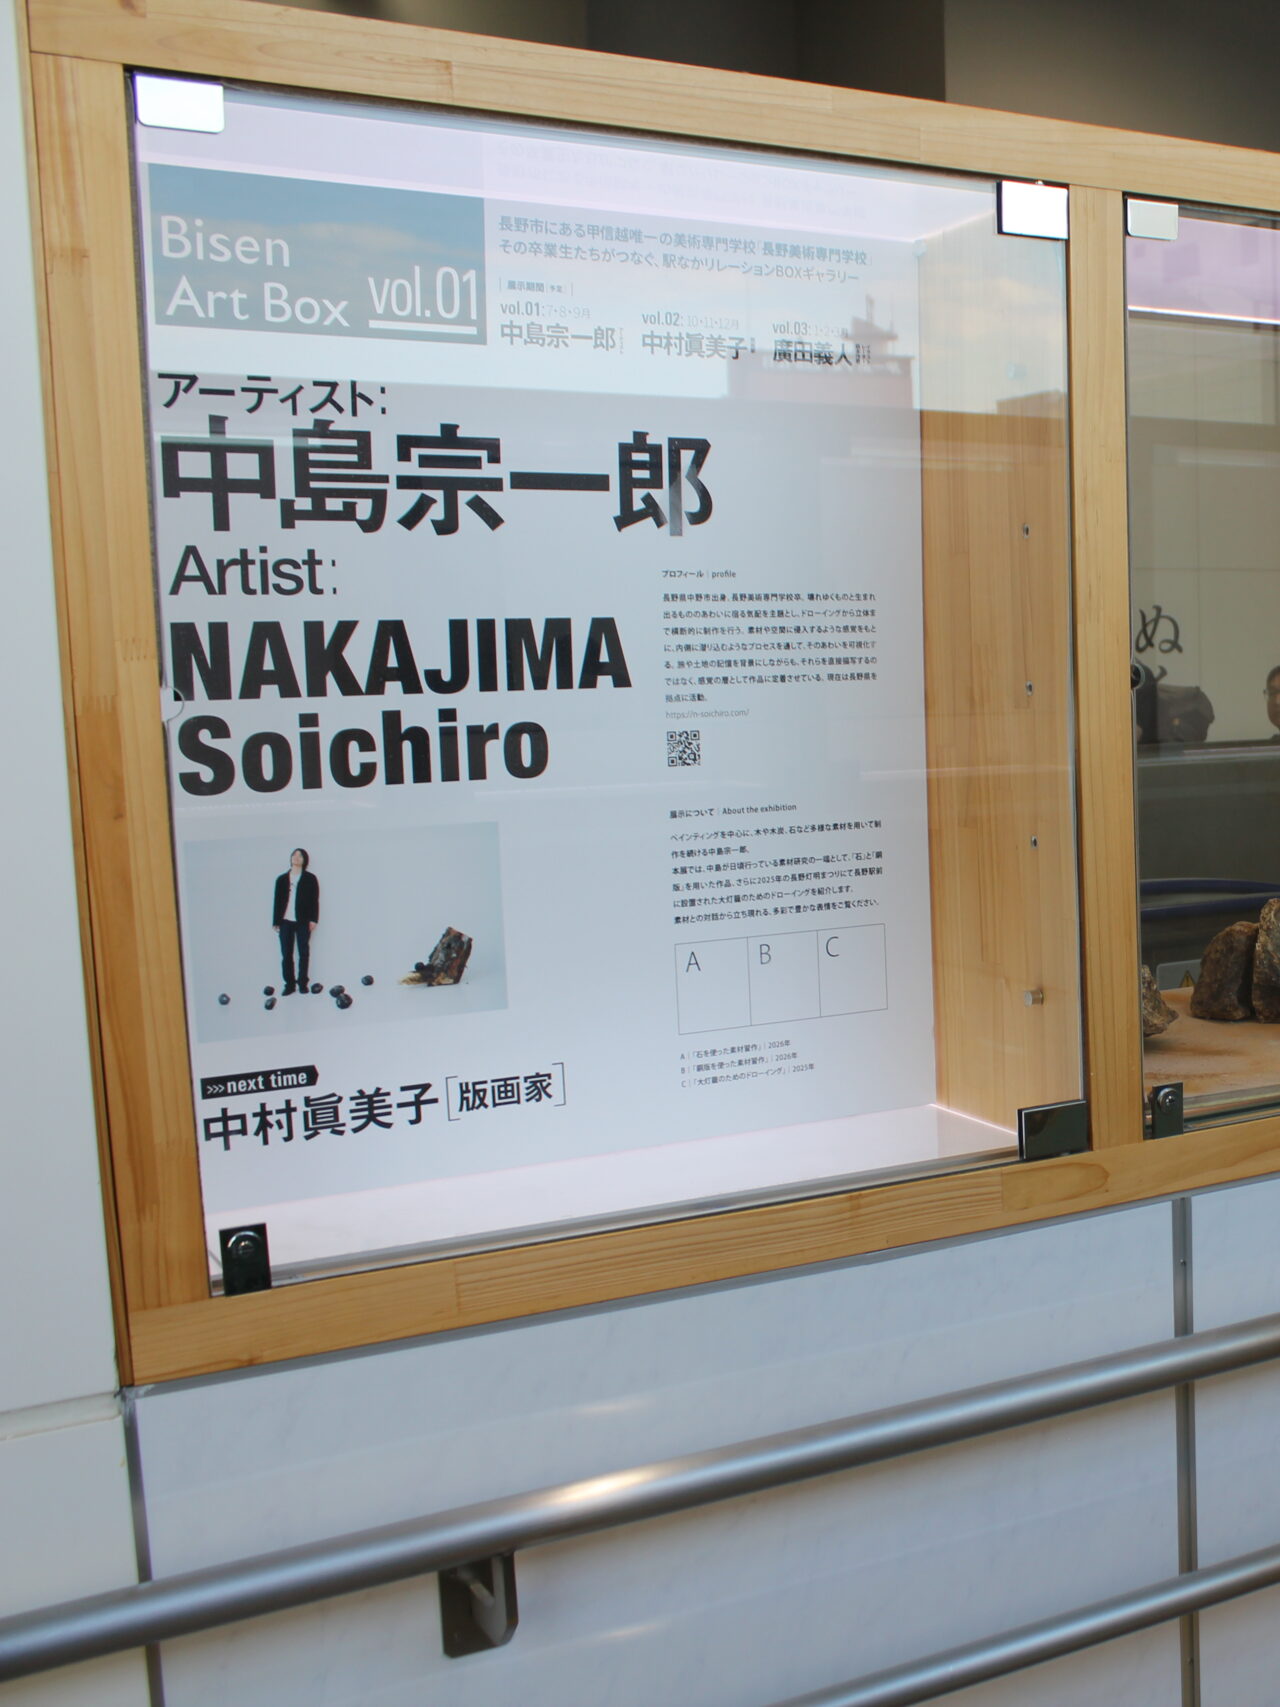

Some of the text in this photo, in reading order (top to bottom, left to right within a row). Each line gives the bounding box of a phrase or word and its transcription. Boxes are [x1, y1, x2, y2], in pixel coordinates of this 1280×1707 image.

[160, 215, 291, 268] Bisen
[165, 275, 351, 328] Art Box
[368, 265, 478, 320] vol.01
[500, 319, 616, 352] 中島宗一郎
[642, 330, 748, 361] 中村眞美子
[773, 339, 853, 367] 廣田義人
[160, 414, 713, 537] 中島宗一郎
[169, 545, 337, 597] Artist:
[662, 570, 737, 580] プロフィール profile
[169, 616, 633, 702] NAKAJIMA
[177, 707, 549, 797] Soichiro
[670, 803, 797, 819] 展示について About the exhibition
[685, 936, 840, 973] A B C
[226, 1069, 307, 1094] next time
[202, 1082, 439, 1152] 中村眞美子
